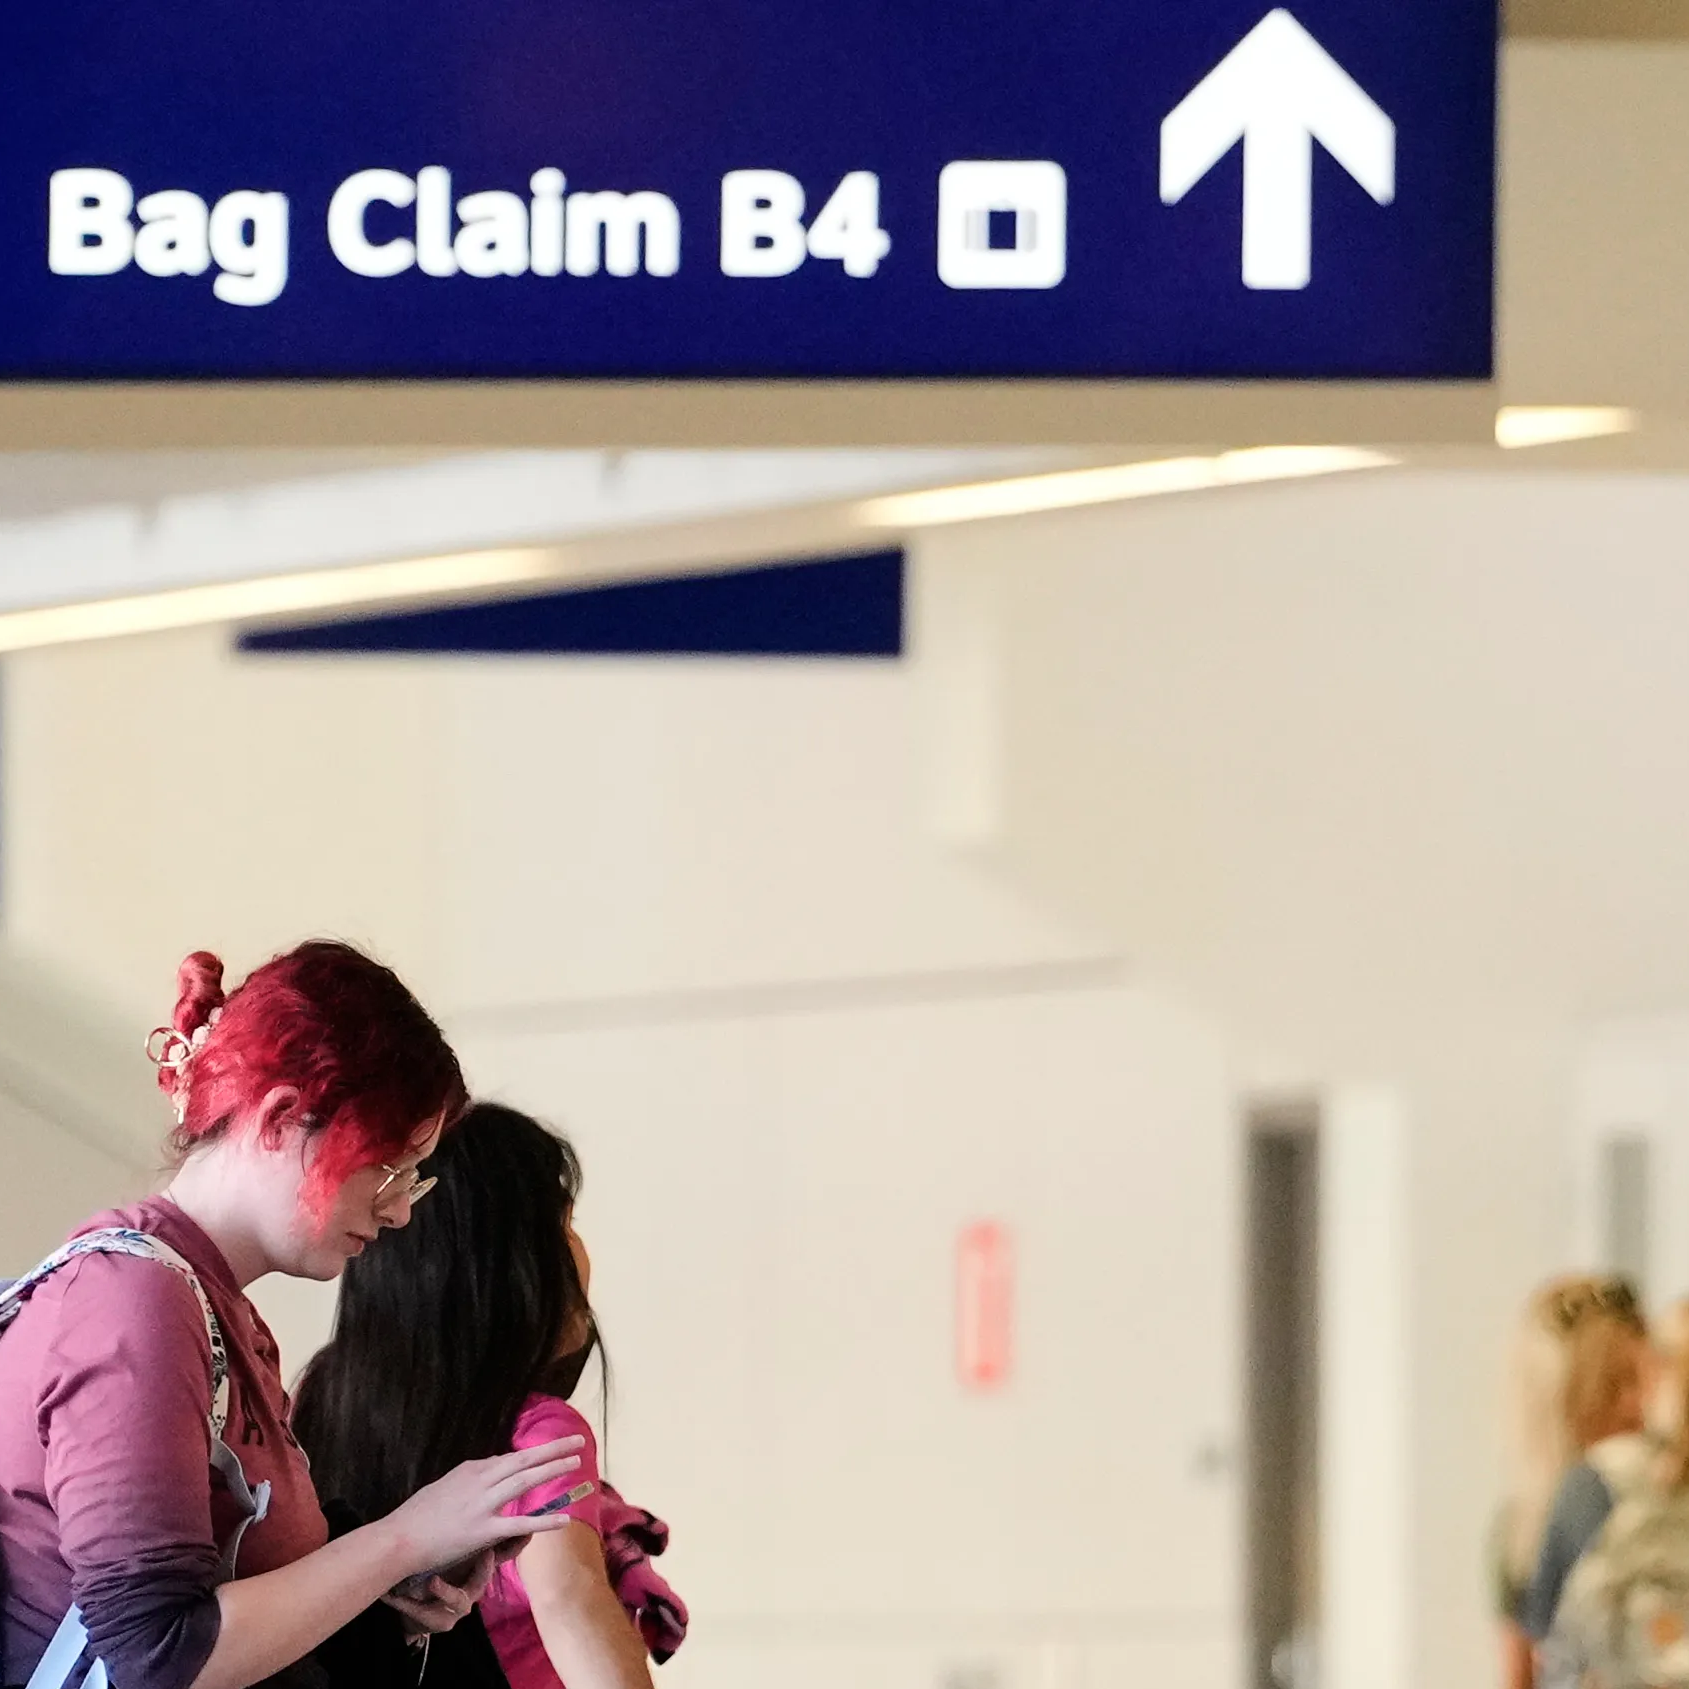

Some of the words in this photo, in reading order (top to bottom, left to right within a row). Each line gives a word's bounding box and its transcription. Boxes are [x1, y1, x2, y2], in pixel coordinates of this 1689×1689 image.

[47, 167, 290, 308] Bag
[326, 164, 682, 279] Claim
[719, 168, 892, 279] B4
